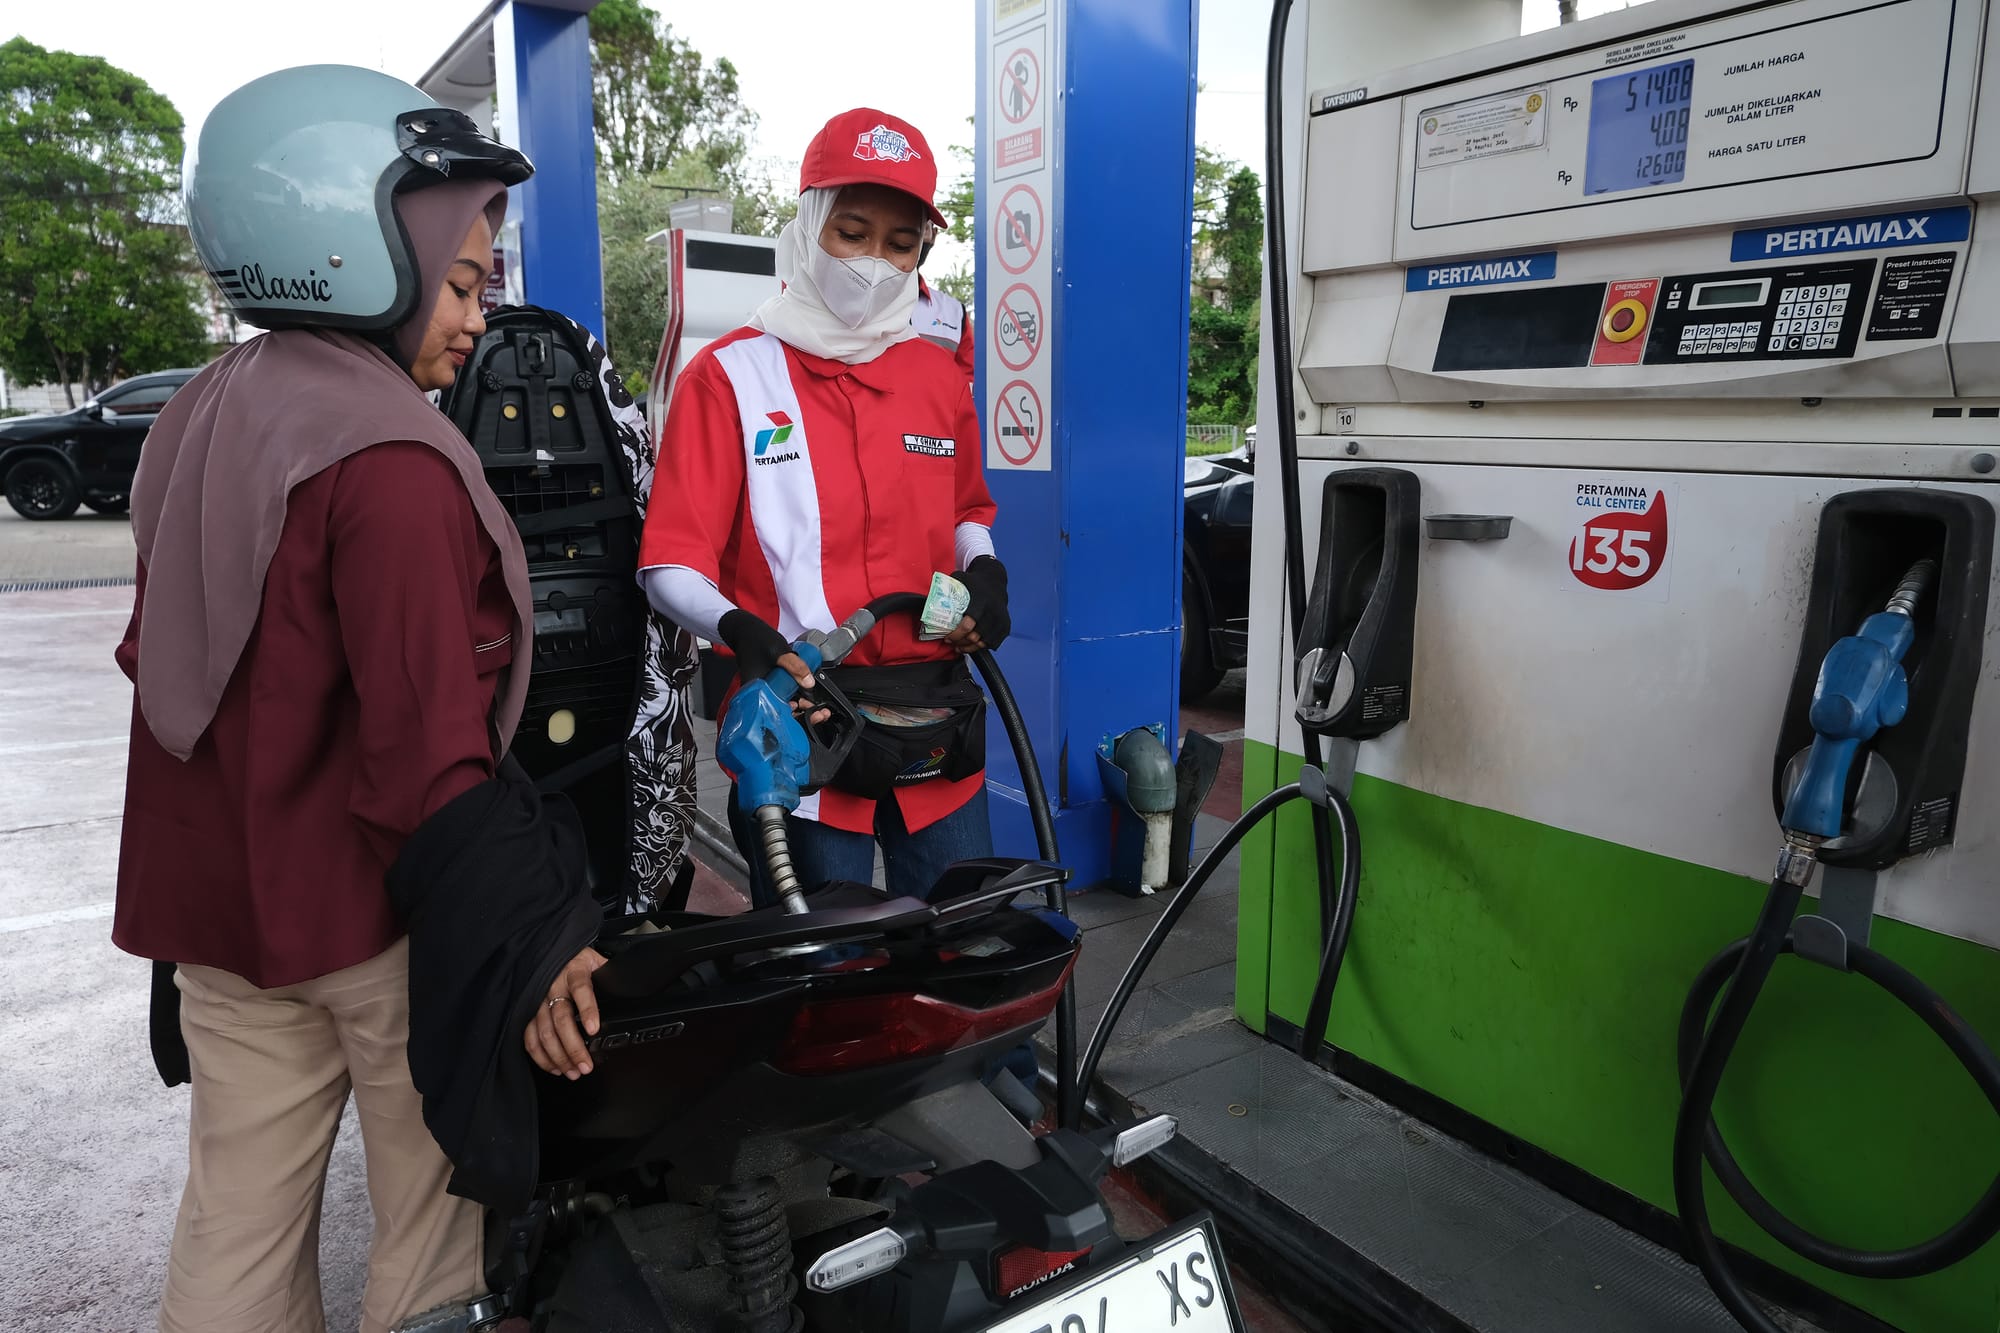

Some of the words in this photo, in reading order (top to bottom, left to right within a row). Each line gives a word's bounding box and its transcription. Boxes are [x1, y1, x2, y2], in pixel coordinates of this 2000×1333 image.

[1723, 60, 1765, 76] JUMLAH
[1767, 51, 1805, 67] HARGA
[1625, 63, 1694, 112] 51408
[1323, 89, 1364, 108] TATSUNO
[1563, 96, 1578, 112] Rp
[1704, 103, 1744, 118] JUMLAH
[1747, 88, 1821, 111] DIKELUARKAN
[1727, 110, 1762, 124] DALAM
[1765, 104, 1795, 118] LITER
[872, 141, 906, 160] MOVE
[1708, 145, 1743, 158] HARGA
[1746, 140, 1773, 152] SATU
[1776, 135, 1806, 148] LITER
[1636, 150, 1686, 179] 12600
[1557, 170, 1572, 185] Rp
[1764, 216, 1930, 253] PERTAMAX
[1427, 259, 1532, 286] PERTAMAX
[1886, 260, 1911, 269] Preset
[1911, 257, 1953, 267] Instruction
[240, 262, 332, 302] Classic
[1615, 281, 1652, 291] EMERGENCY
[1002, 322, 1016, 334] ON
[1340, 415, 1352, 425] 10
[754, 451, 801, 466] PERTAMINA
[1576, 484, 1648, 498] PERTAMINA
[1576, 496, 1602, 508] CALL
[1605, 498, 1647, 510] CENTER
[1572, 525, 1651, 578] 135
[896, 768, 942, 781] PERTAMINA
[1156, 1251, 1215, 1328] XS
